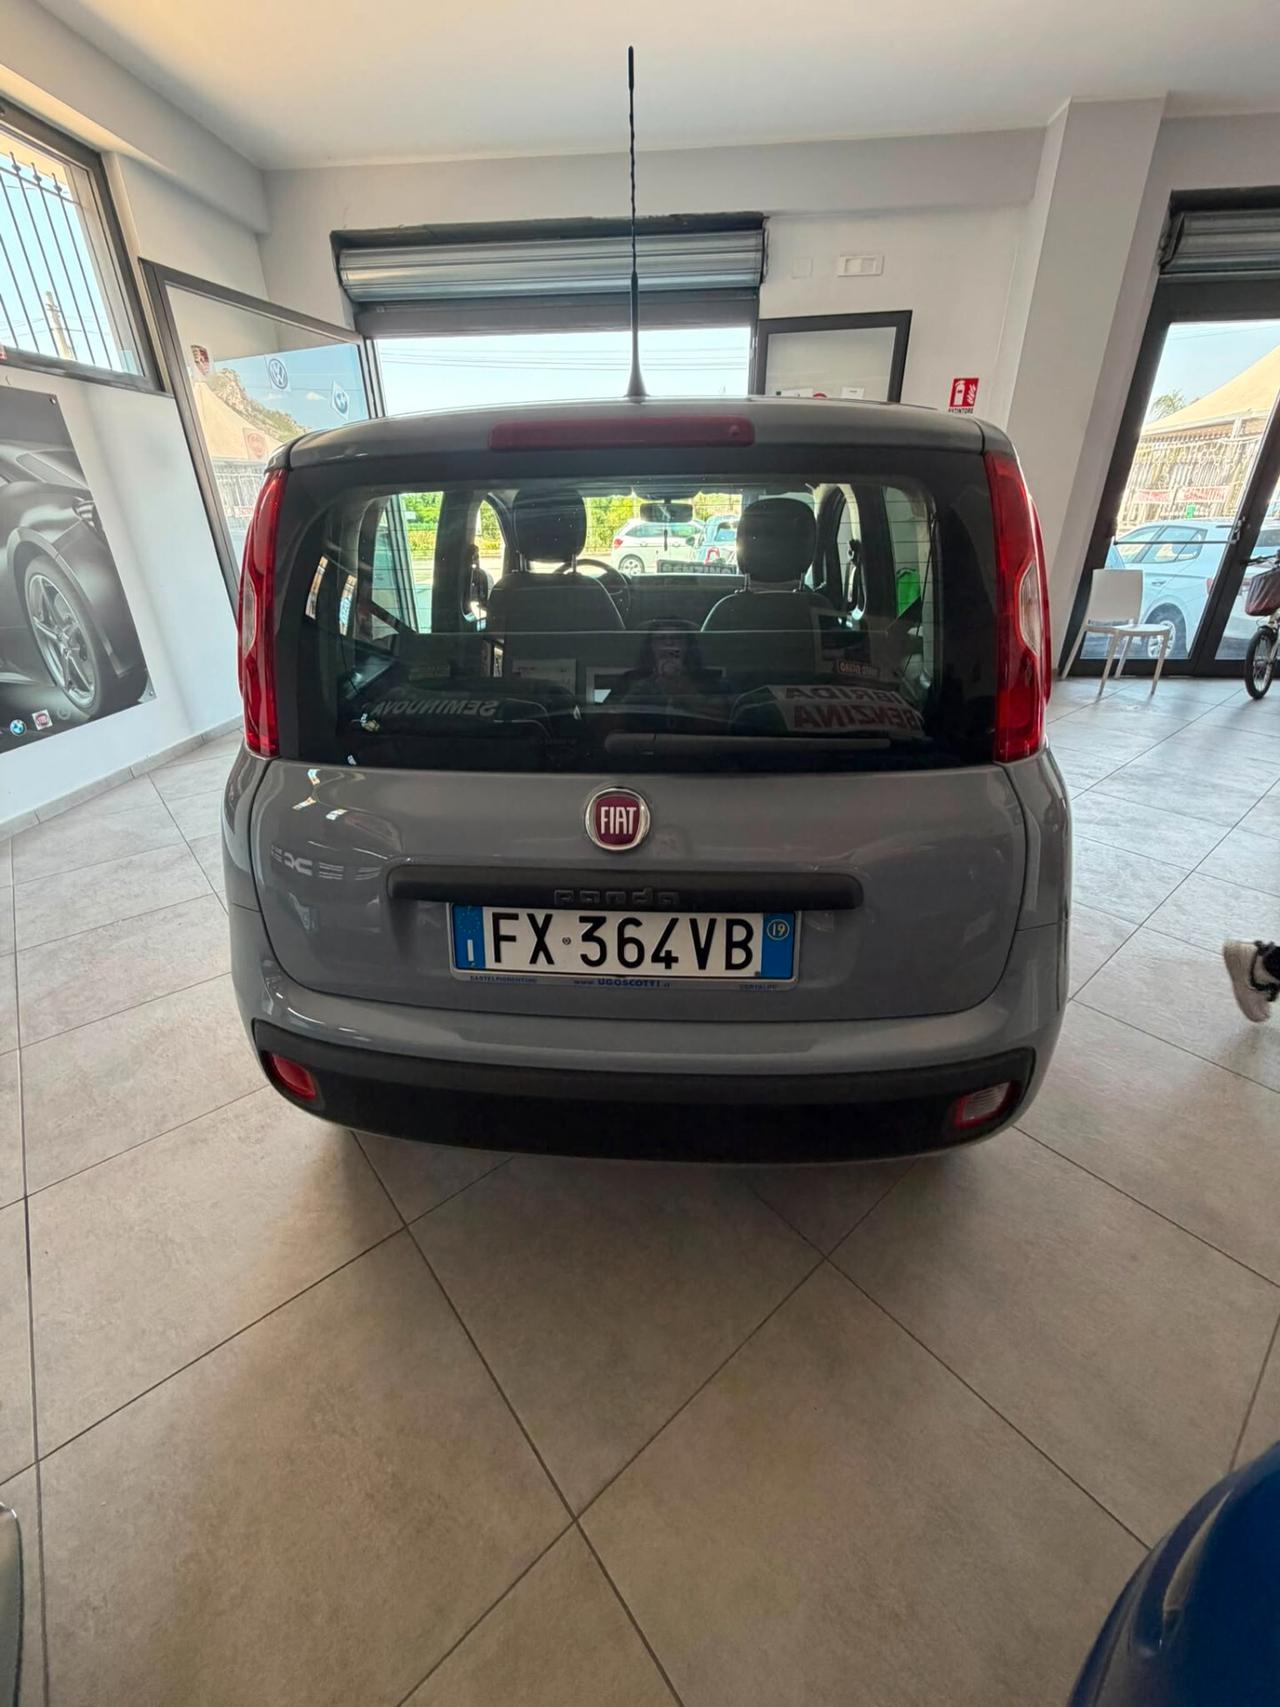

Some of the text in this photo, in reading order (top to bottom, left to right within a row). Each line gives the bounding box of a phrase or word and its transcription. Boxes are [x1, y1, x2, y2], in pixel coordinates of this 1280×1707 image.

[600, 806, 637, 834] FIAT
[492, 912, 754, 970] FX 364VB
[771, 923, 786, 937] 19
